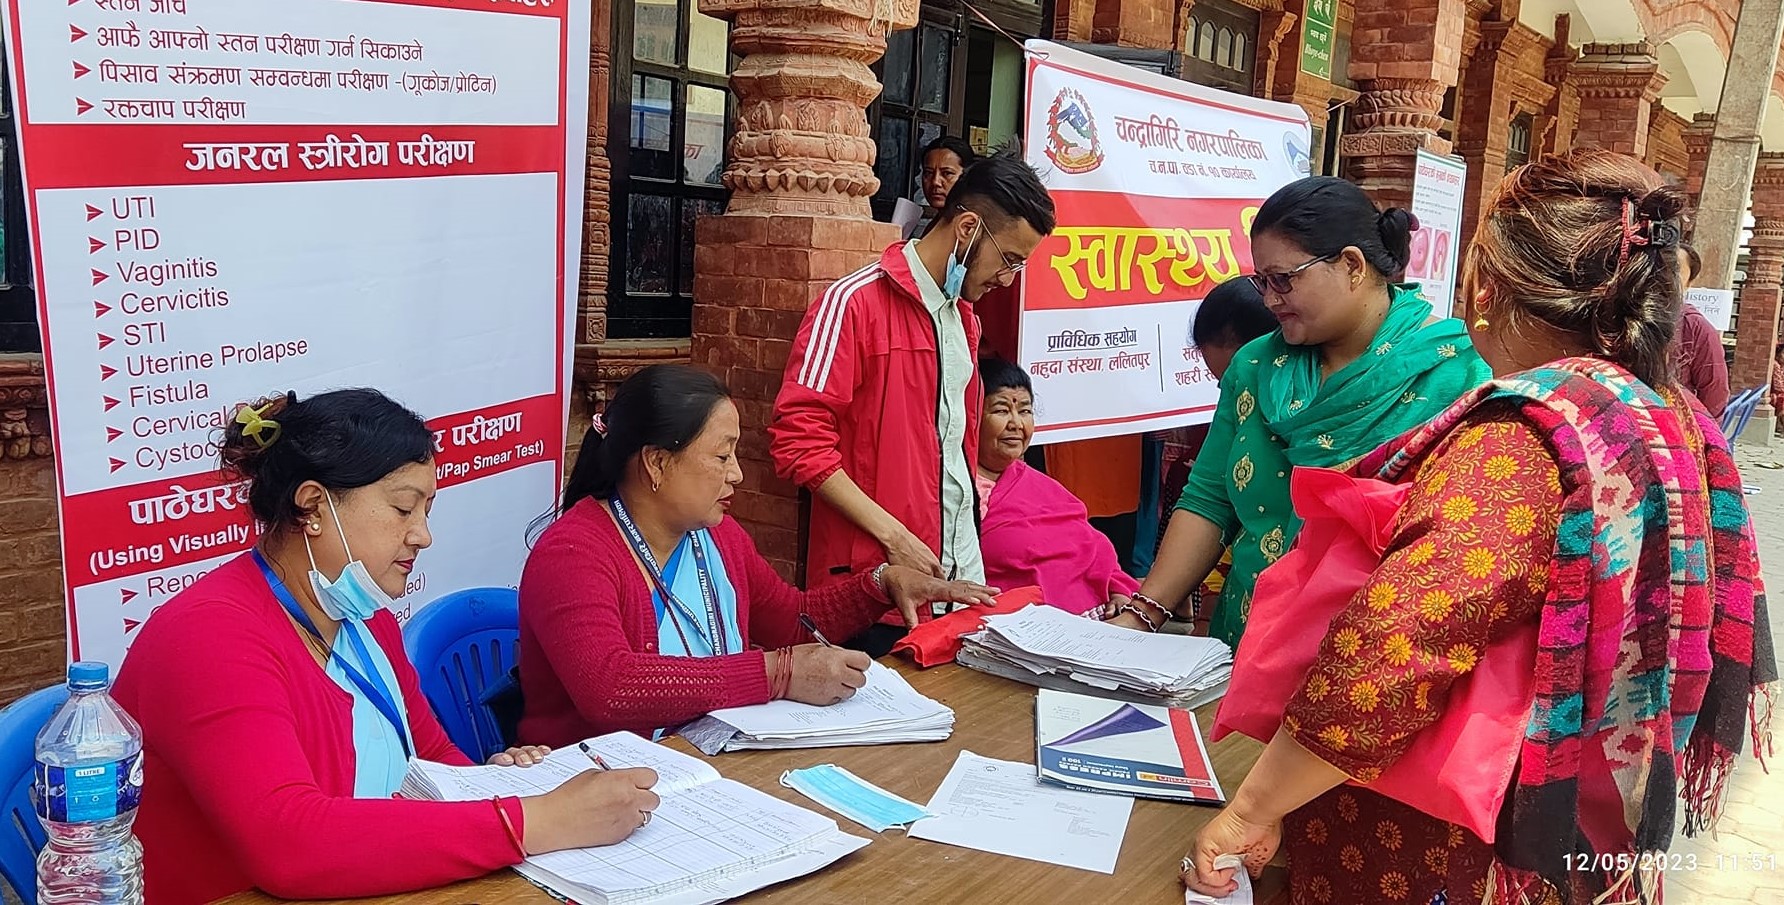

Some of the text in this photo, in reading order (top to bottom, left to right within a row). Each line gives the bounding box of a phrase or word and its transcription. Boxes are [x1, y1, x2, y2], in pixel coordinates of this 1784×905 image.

[97, 20, 423, 61] आफै आफ्नो स्तन परीक्षण गर्न सिकाउने
[99, 59, 159, 83] पिसाव
[166, 61, 241, 86] संक्रमण
[337, 69, 388, 92] परीक्षण
[102, 96, 246, 121] रक्तचाप परीक्षण
[183, 133, 475, 171] जनरल स्त्रीरोग परीक्षण
[1114, 113, 1184, 152] चन्द्रागिरि
[1184, 129, 1269, 160] नगरपालिका
[112, 196, 155, 220] UTI
[115, 228, 160, 252] PID
[117, 256, 218, 287] Vaginitis
[1050, 226, 1241, 300] स्वास्थ्य
[121, 286, 229, 315] Cervicitis
[124, 321, 166, 346] STI
[1047, 326, 1137, 351] प्राविधिक सहयोग
[127, 339, 308, 377] Uterine Prolapse
[1108, 350, 1151, 370] ललितपुर
[1174, 366, 1201, 386] शहरी
[129, 380, 209, 408] Fistula
[133, 405, 227, 439] Cervical
[452, 411, 523, 447] परीक्षण
[136, 438, 222, 471] Cystoc
[436, 439, 545, 481] t/Pap Smear Test)
[89, 543, 164, 576] (Using
[169, 524, 250, 554] Visually
